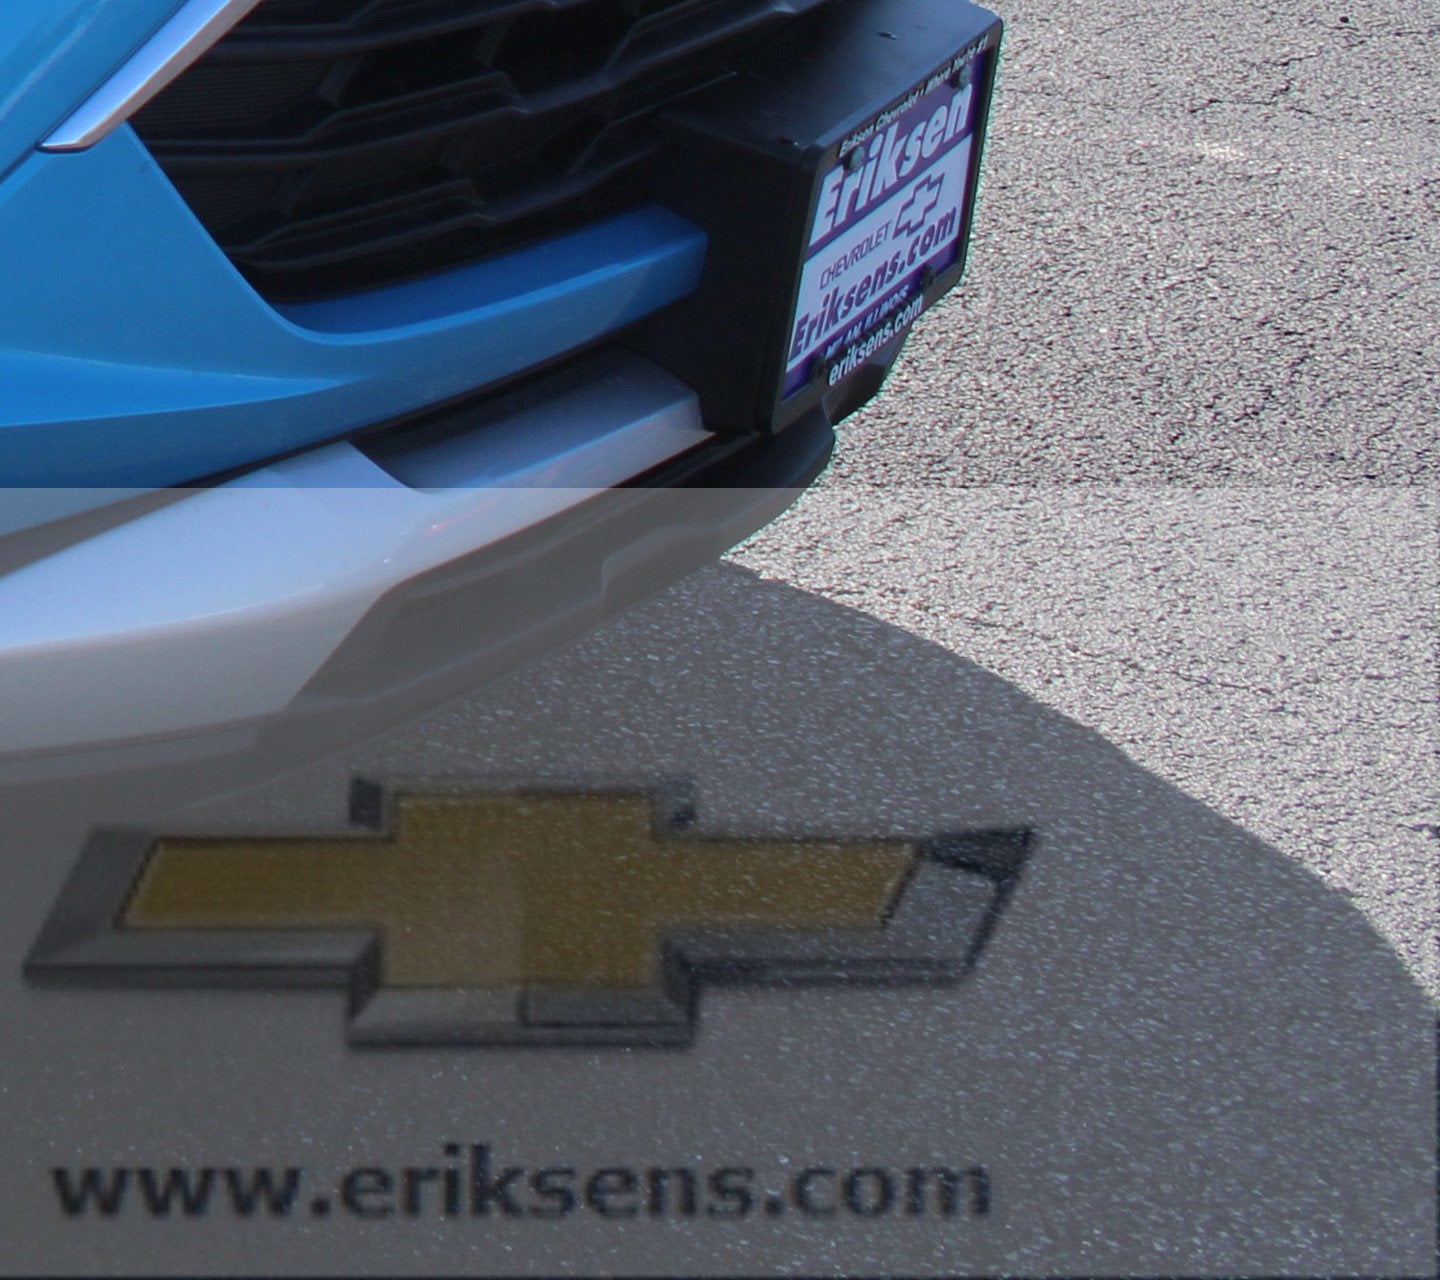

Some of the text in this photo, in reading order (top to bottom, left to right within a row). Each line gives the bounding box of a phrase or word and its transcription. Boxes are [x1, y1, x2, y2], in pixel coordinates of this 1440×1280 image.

[809, 83, 973, 246] Eriksen
[789, 206, 957, 358] Eriksens.com
[819, 220, 893, 290] CHEVROLET
[828, 294, 924, 387] eriksens.com
